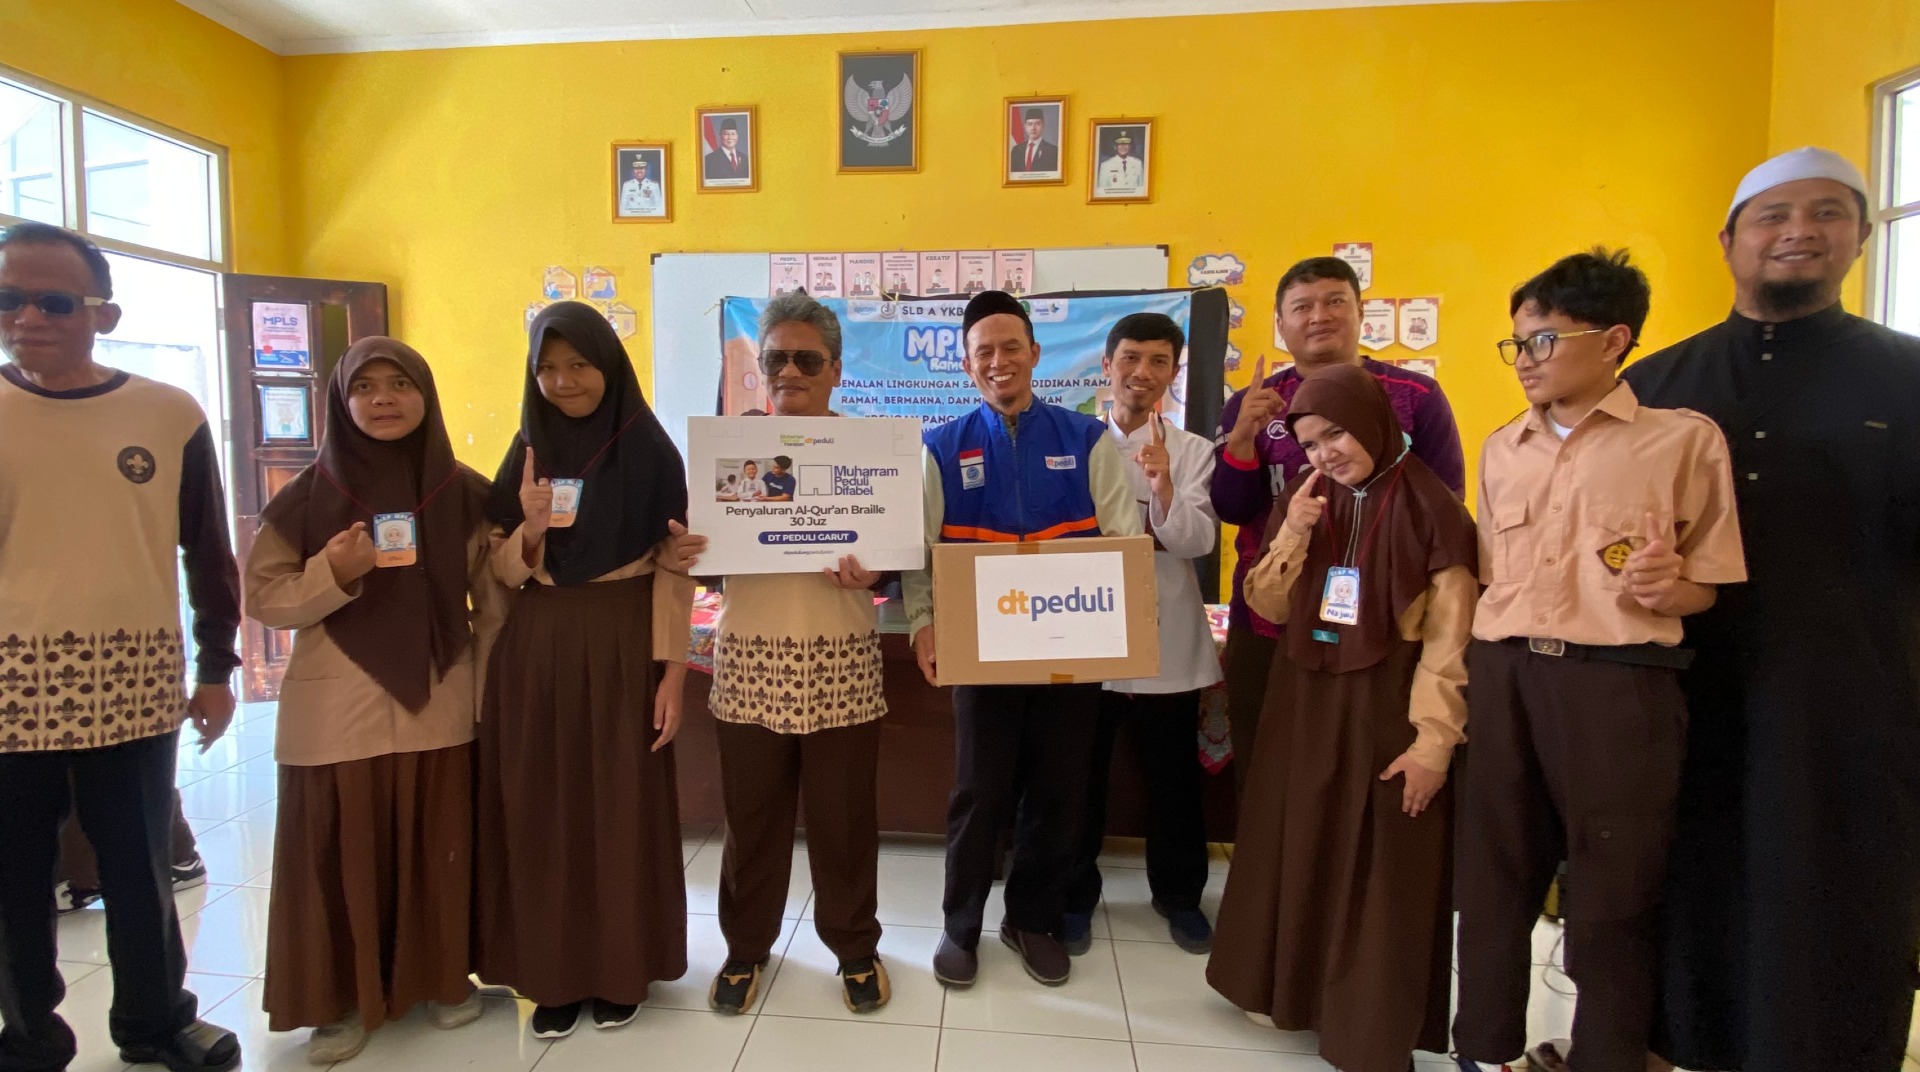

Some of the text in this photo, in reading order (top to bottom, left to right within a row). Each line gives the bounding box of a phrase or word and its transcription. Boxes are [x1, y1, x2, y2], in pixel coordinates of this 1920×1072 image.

[902, 307, 923, 316] SLB
[928, 307, 936, 316] A
[263, 316, 298, 326] MPLS
[840, 379, 883, 389] ENALAN
[887, 379, 960, 389] LINGKUNGAN
[1031, 379, 1080, 388] DIDIKAN
[841, 396, 881, 405] RAMAH,
[884, 396, 944, 406] BERMAKNA,
[947, 396, 970, 405] DAN
[834, 465, 899, 477] Muharram
[834, 476, 869, 486] Peduli
[834, 485, 874, 496] Difabel
[725, 504, 886, 517] Penyaluran Al-Qur'an Braille
[790, 516, 827, 527] 30 Juz
[767, 533, 849, 542] DT PEDULI GARUT
